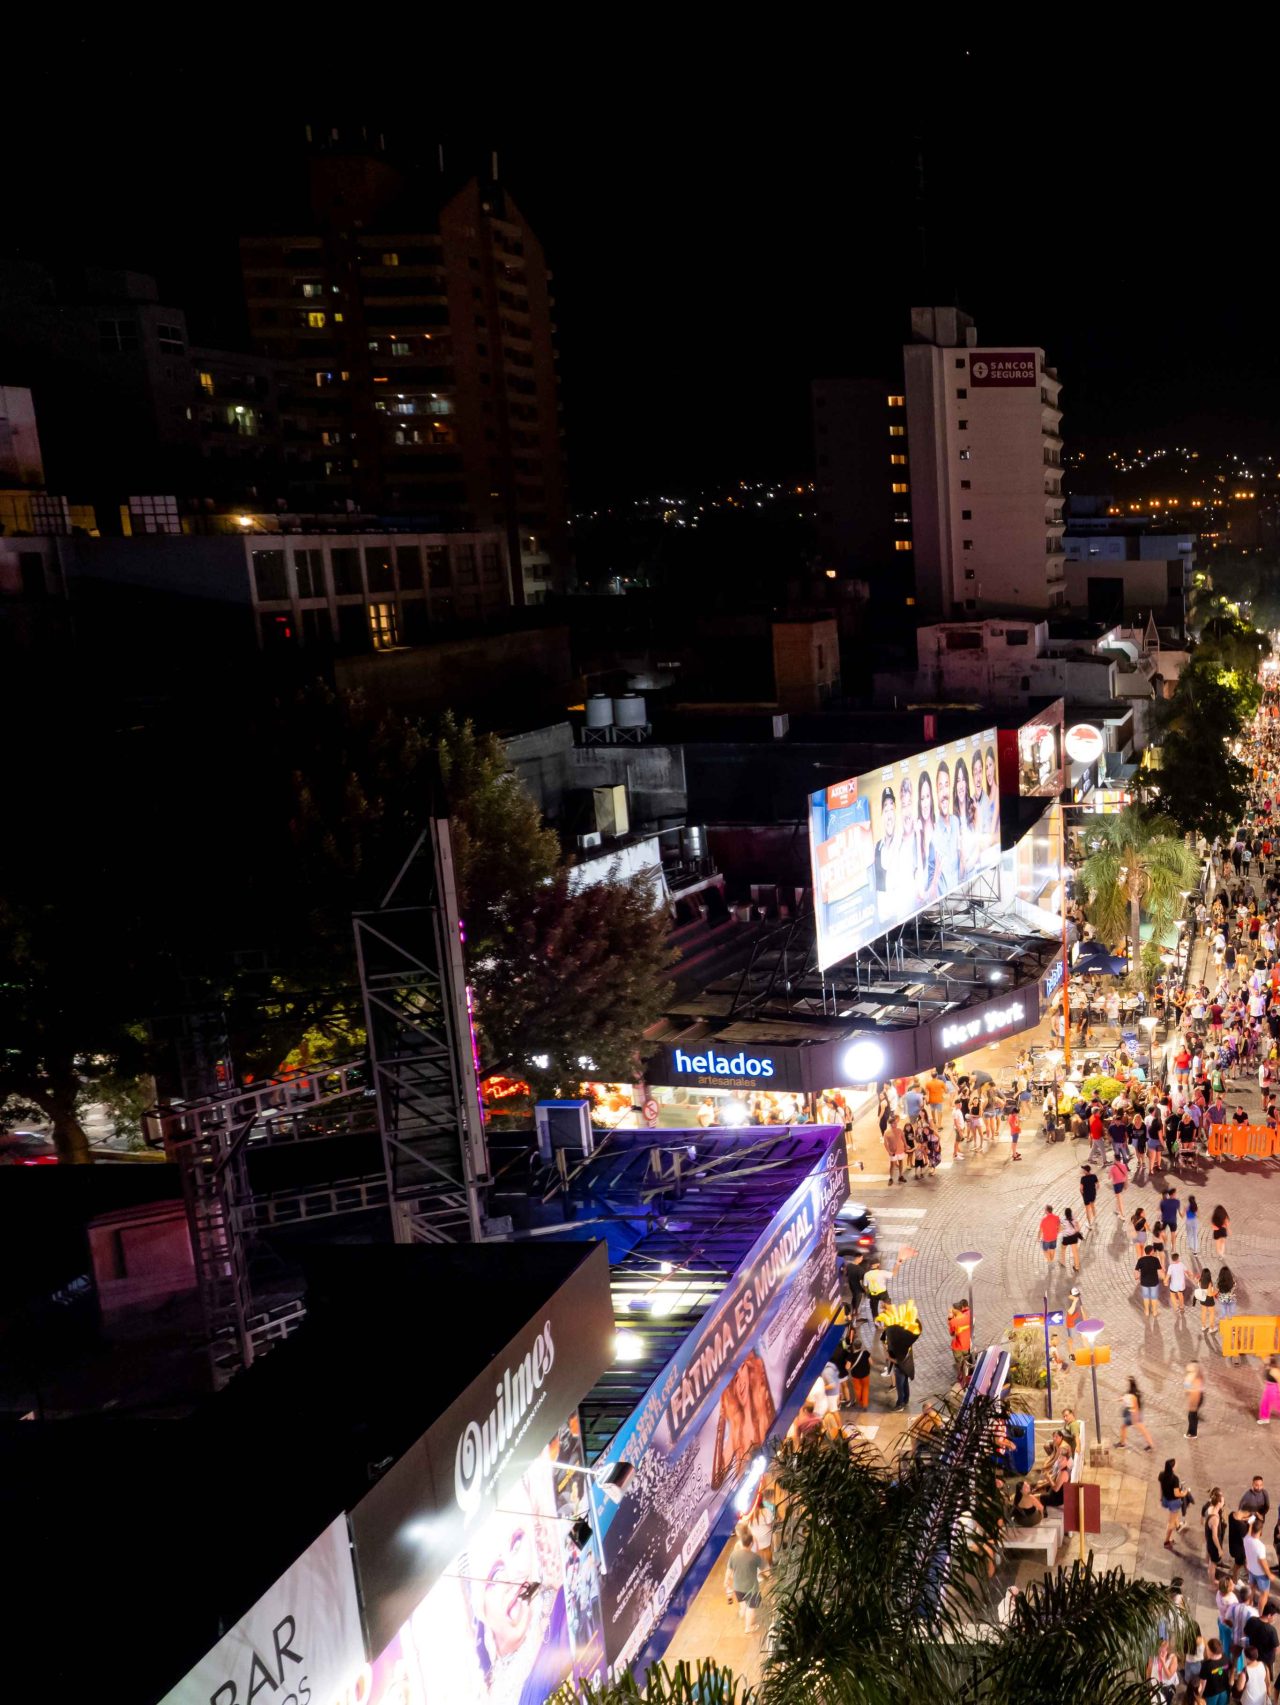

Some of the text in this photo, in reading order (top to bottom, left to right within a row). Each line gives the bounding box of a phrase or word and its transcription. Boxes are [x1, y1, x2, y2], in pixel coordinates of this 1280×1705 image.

[991, 362, 1034, 370] SANCOR
[991, 371, 1034, 379] SEGUROS
[942, 1002, 1025, 1048] New York
[674, 1049, 774, 1078] helados
[697, 1076, 757, 1088] artesanales
[820, 1174, 844, 1211] Holiday
[669, 1322, 736, 1430] FÁTIMA
[735, 1291, 755, 1334] ES
[755, 1205, 816, 1304] MUNDIAL
[454, 1320, 555, 1530] Quilmes
[515, 1391, 547, 1447] ARGENTINA
